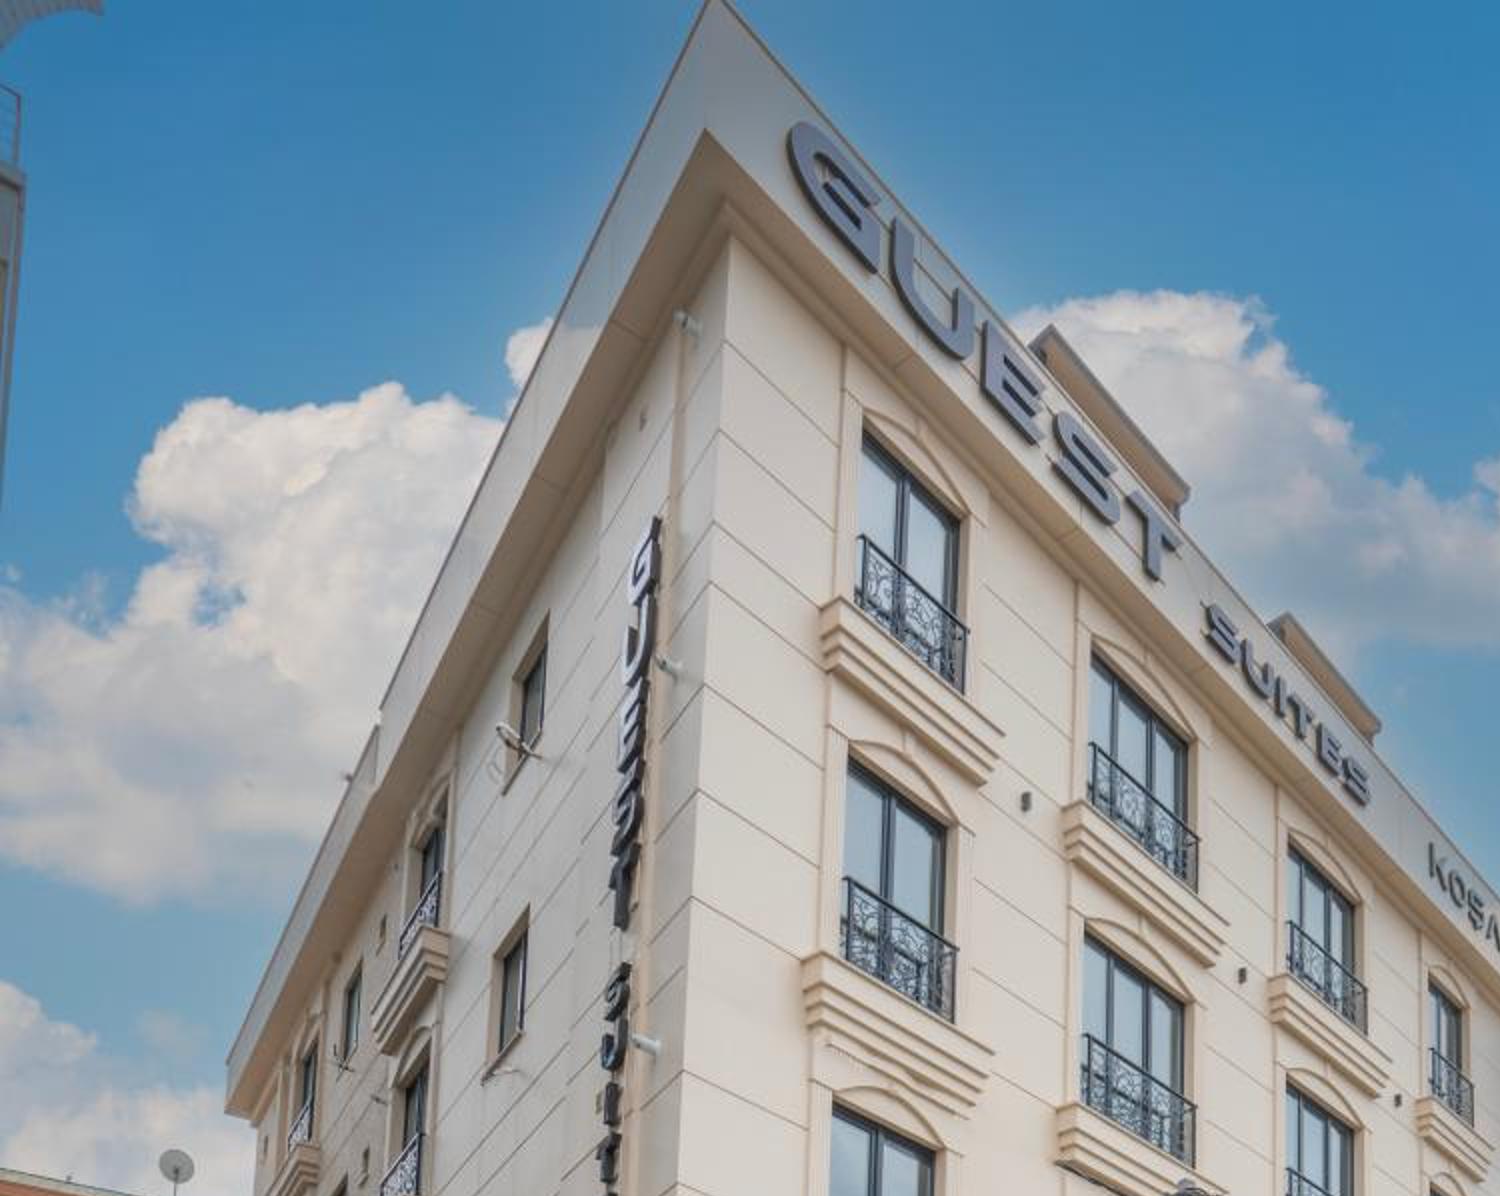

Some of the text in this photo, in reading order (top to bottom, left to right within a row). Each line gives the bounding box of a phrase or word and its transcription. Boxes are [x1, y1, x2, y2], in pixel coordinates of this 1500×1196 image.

[607, 515, 663, 933] GUEST
[786, 121, 1371, 807] GUEST SUITES
